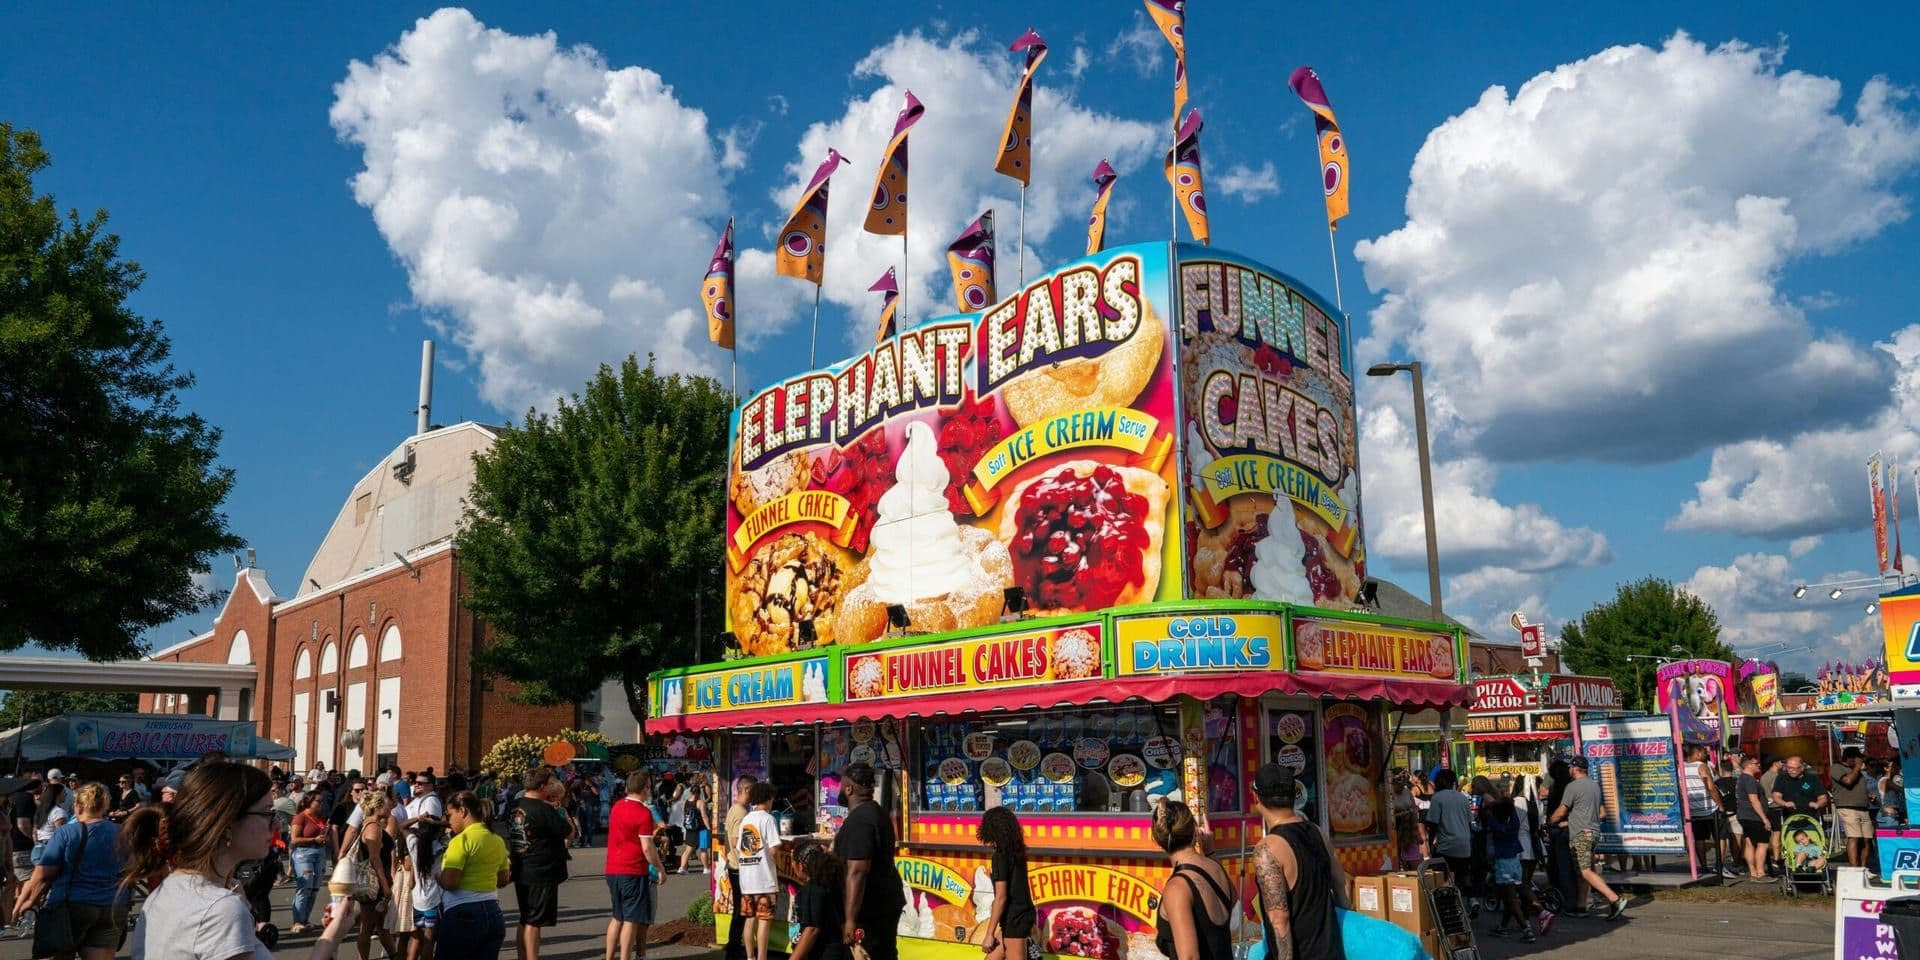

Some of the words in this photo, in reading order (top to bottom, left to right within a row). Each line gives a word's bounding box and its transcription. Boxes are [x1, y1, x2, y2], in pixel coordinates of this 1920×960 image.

[1180, 262, 1351, 393] FUNNEL
[741, 326, 971, 470] ELEPHANT
[987, 257, 1142, 388] EARS
[988, 453, 1006, 475] Soft
[1008, 430, 1036, 467] ICE
[1045, 410, 1116, 448] CREAM
[1118, 416, 1147, 438] Serve
[1201, 369, 1342, 485] CAKES
[1215, 469, 1233, 490] Soft
[1234, 460, 1259, 490] ICE
[1267, 461, 1320, 508] CREAM
[745, 498, 790, 542] FUNNEL
[798, 494, 838, 520] CAKES
[1168, 617, 1237, 639] COLD
[887, 647, 966, 692] FUNNEL
[974, 636, 1048, 681] CAKES
[1133, 635, 1271, 671] DRINKS
[1321, 629, 1396, 671] ELEPHANT
[1401, 633, 1434, 673] EARS
[696, 677, 722, 709] ICE
[727, 667, 795, 705] CREAM
[1476, 683, 1514, 697] PIZZA
[1551, 683, 1579, 706] PIZZA
[1579, 683, 1615, 706] PARLOR
[103, 731, 228, 753] CARICATURES
[143, 721, 193, 730] AIRBRUSHED
[1588, 744, 1623, 757] SIZE
[1626, 742, 1668, 756] WIZE
[945, 875, 965, 897] Serve
